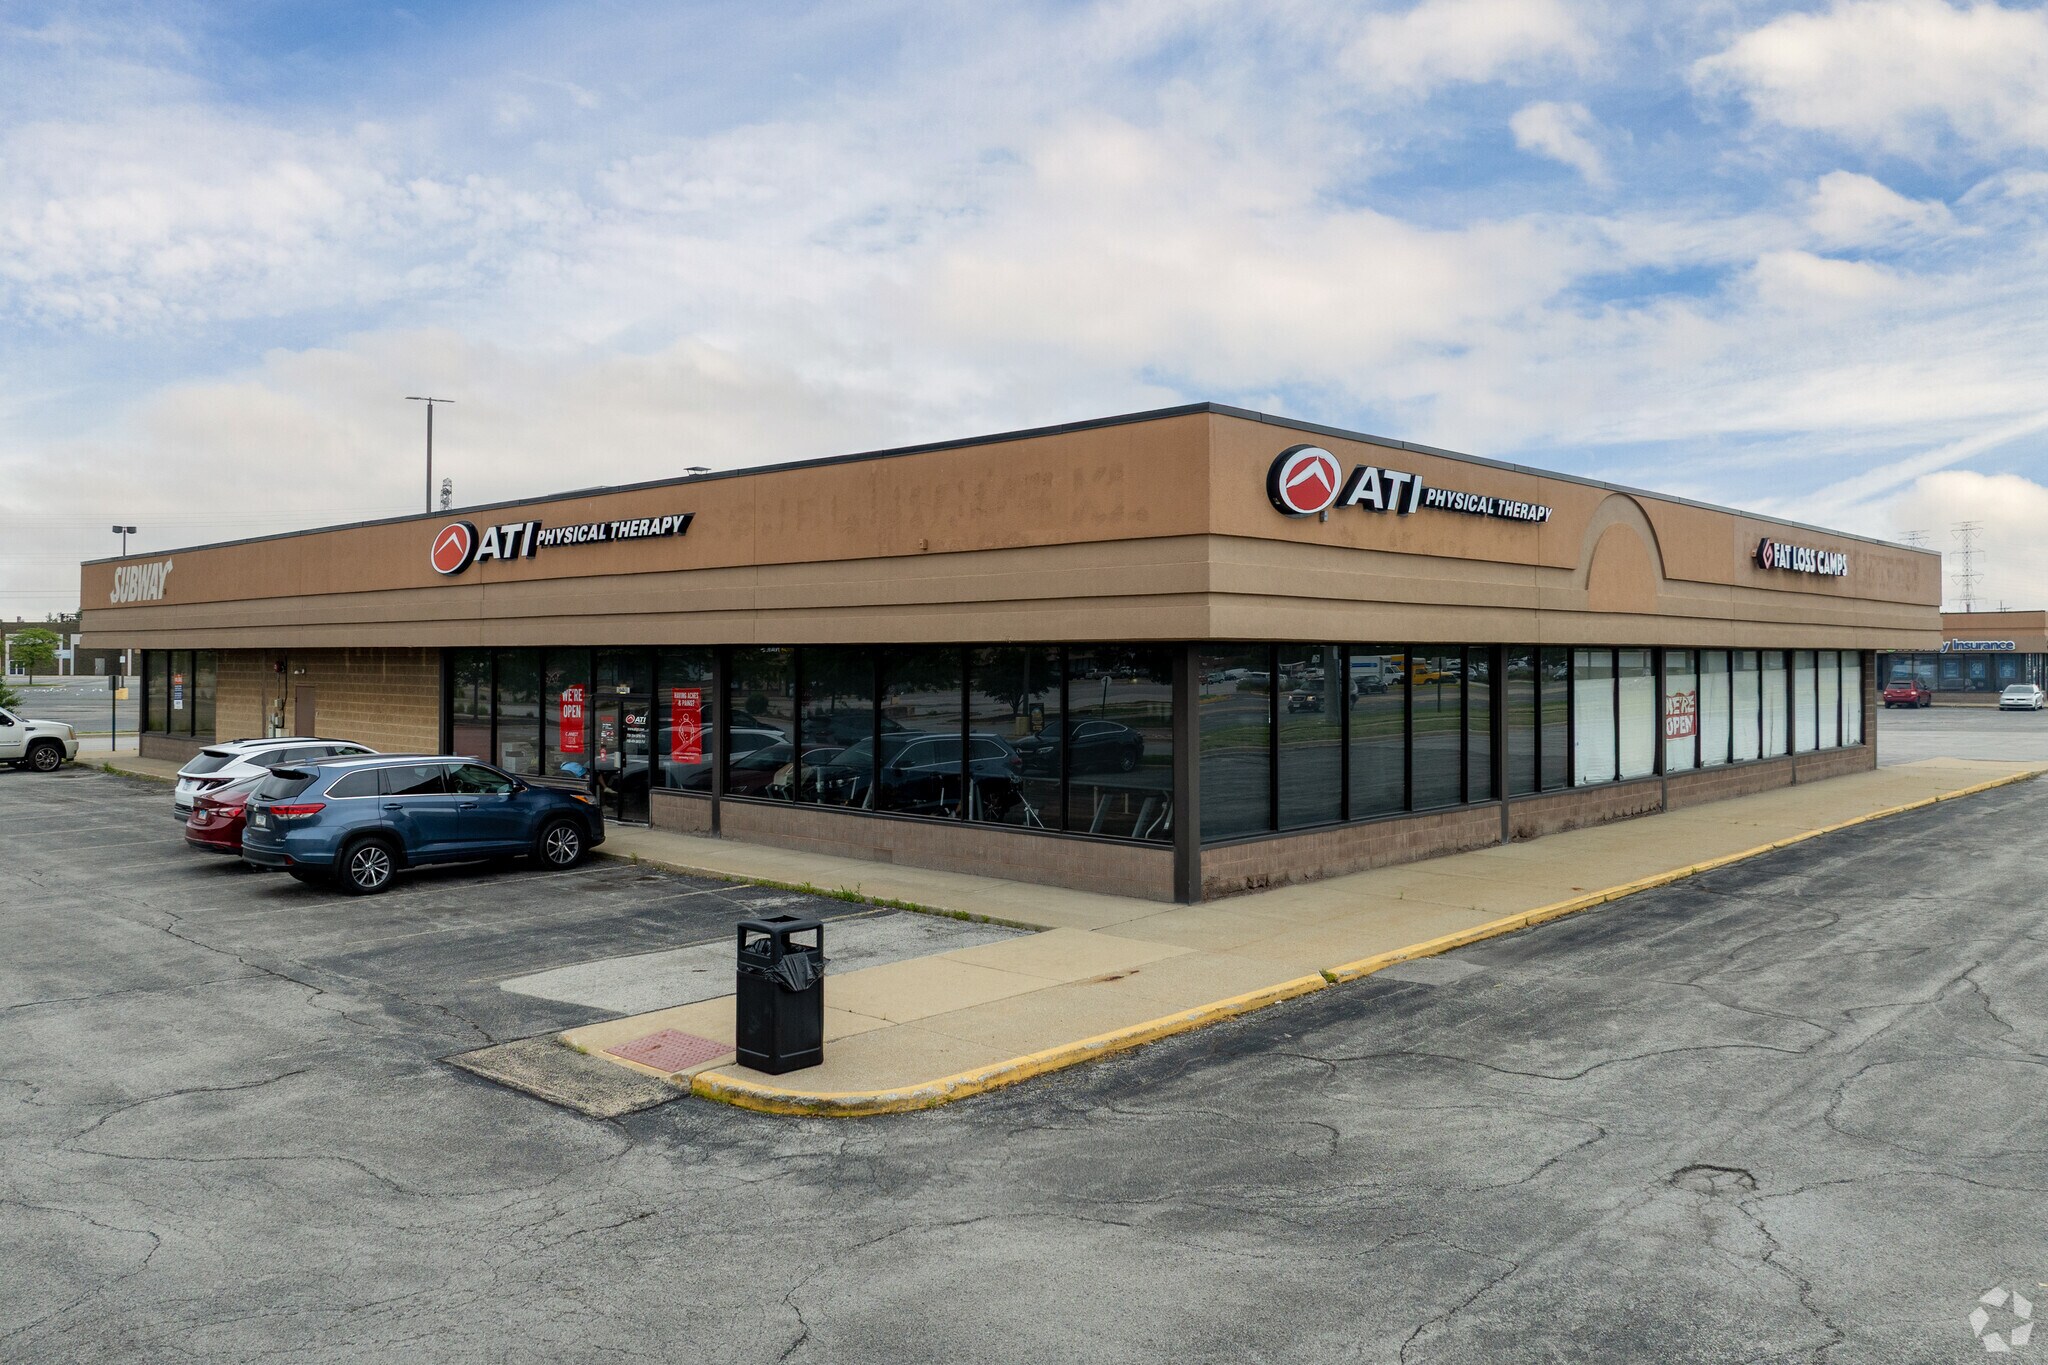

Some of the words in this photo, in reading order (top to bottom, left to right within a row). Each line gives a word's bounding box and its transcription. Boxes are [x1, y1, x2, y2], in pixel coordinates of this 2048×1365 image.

[1347, 466, 1423, 514] ATI
[1425, 488, 1494, 515] PHYSICAL
[1498, 499, 1553, 523] THERAPY
[473, 521, 534, 562] ATI
[536, 523, 607, 546] PHYSICAL
[610, 514, 685, 538] THERAPY
[1773, 542, 1792, 570] FAT
[1793, 546, 1816, 573] LOSS
[1817, 550, 1848, 577] CAMPS
[110, 557, 173, 604] SUBWAY
[1952, 638, 2016, 651] Insurance
[562, 688, 583, 702] WE'RE
[563, 704, 582, 718] OPEN
[1666, 714, 1694, 736] OPEN
